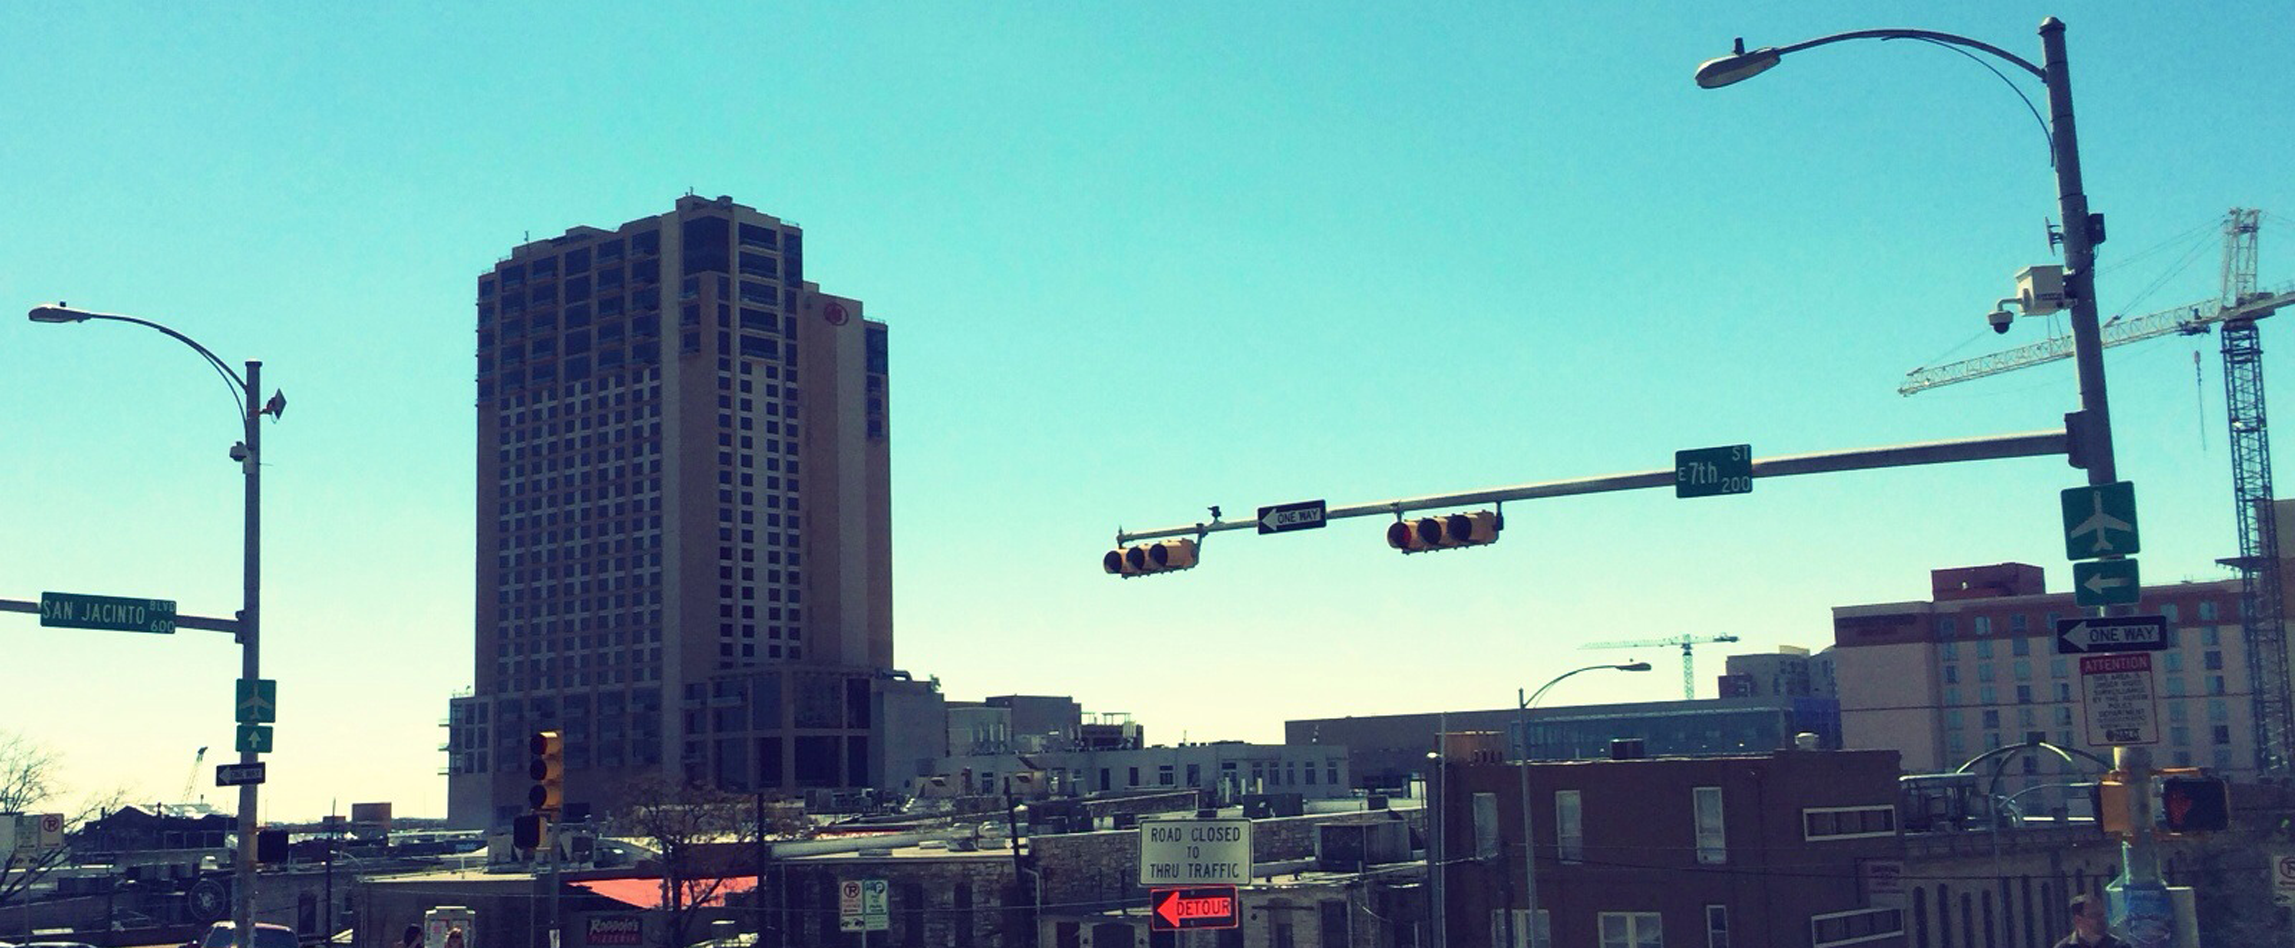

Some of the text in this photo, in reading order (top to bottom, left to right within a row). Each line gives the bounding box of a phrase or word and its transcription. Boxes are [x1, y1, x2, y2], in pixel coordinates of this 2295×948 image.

[1732, 445, 1749, 461] ST
[1678, 461, 1718, 485] E 7th
[1721, 475, 1751, 493] 200
[1277, 508, 1319, 524] ONE WAY
[42, 600, 145, 624] SAN JACINTO
[149, 600, 176, 612] BLVD
[150, 620, 176, 632] 600
[2089, 626, 2155, 642] ONE WAY
[2085, 656, 2149, 671] ATTENTION
[1151, 826, 1241, 842] ROAD CLOSED
[1186, 845, 1200, 859] TO
[1149, 863, 1240, 878] THRU TRAFFIC
[1176, 899, 1231, 916] DETOUR
